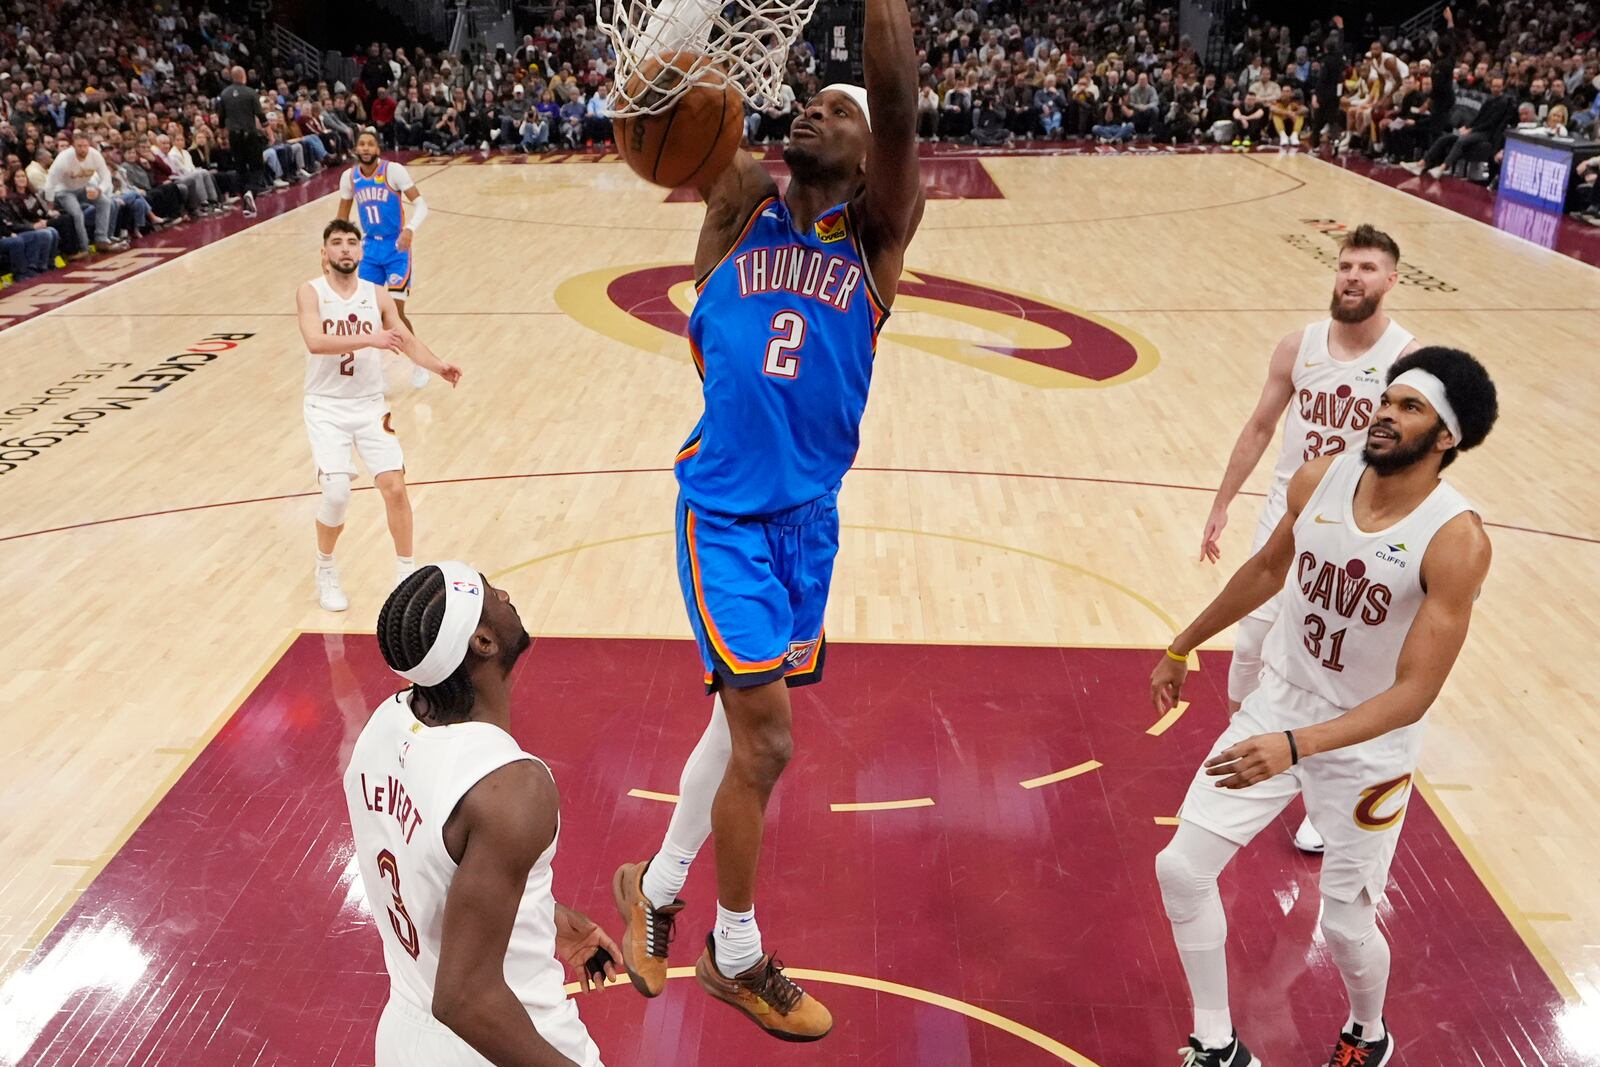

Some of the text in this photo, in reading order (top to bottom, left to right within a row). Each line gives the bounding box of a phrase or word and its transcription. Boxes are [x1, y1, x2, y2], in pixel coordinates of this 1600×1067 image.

[365, 205, 381, 224] 11
[735, 245, 863, 312] THUNDER
[322, 317, 373, 336] CAVS
[762, 309, 806, 378] 2
[340, 351, 354, 376] 2
[1300, 387, 1373, 431] CAVS
[0, 397, 149, 475] Mortga
[1303, 430, 1346, 462] 32
[1375, 551, 1407, 568] CLIFFS
[1297, 551, 1392, 626] CAVS
[1303, 612, 1348, 673] 31
[376, 848, 420, 961] 3
